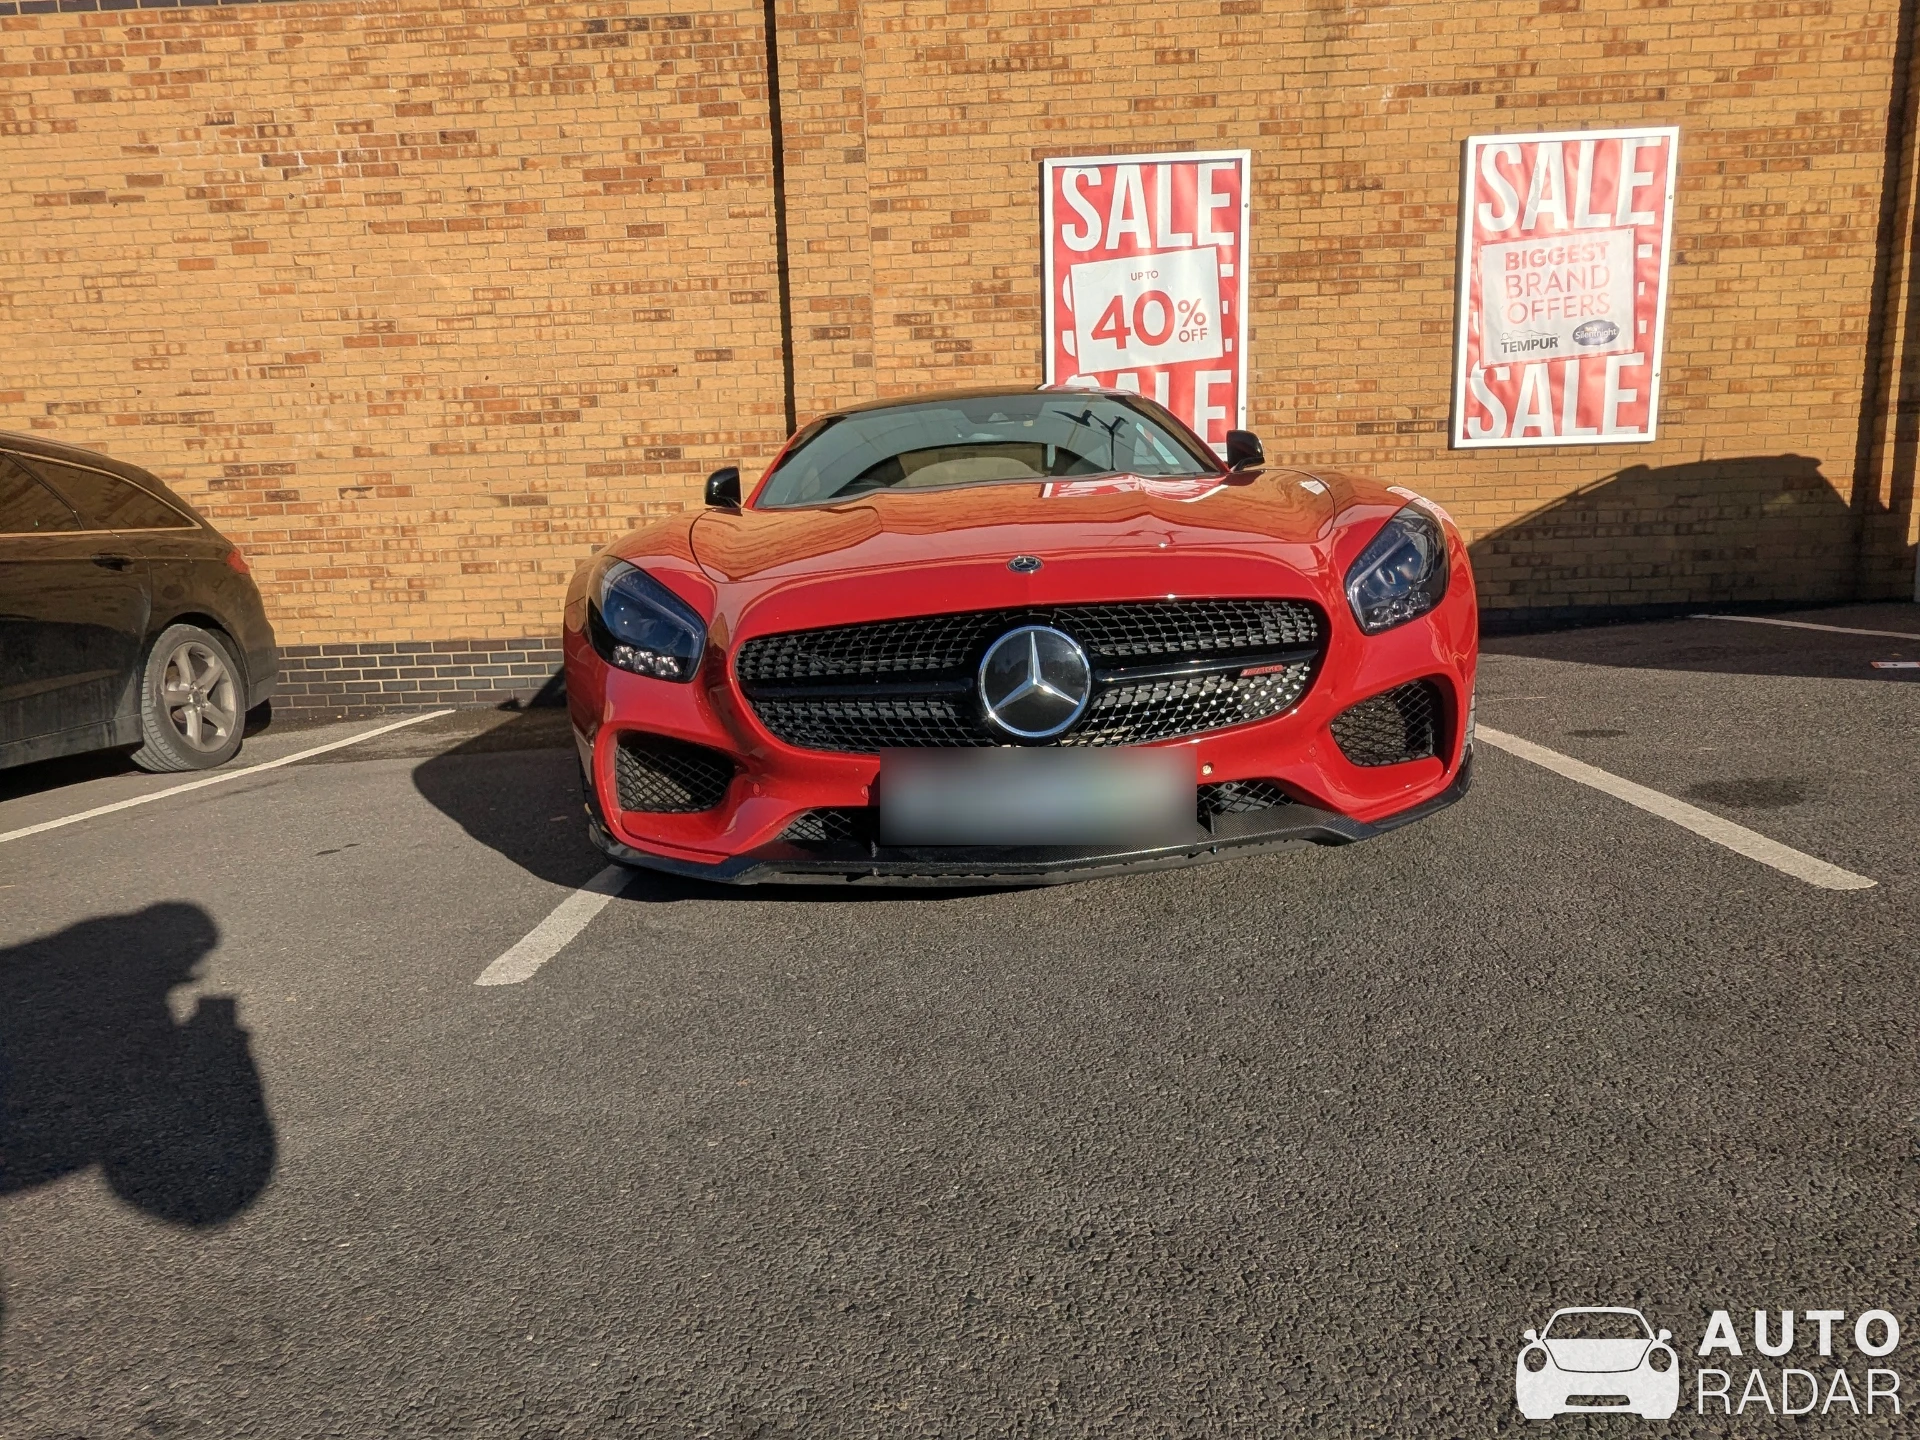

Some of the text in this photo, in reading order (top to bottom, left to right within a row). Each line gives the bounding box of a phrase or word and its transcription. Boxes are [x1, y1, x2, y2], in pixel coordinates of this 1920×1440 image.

[1478, 136, 1662, 232] SALE
[1061, 161, 1236, 252] SALE
[1505, 241, 1610, 271] BIGGEST
[1130, 270, 1159, 281] UP TO
[1505, 264, 1610, 299] BRAND
[1507, 292, 1611, 324] OFFERS
[1178, 328, 1208, 343] OFF
[1501, 337, 1559, 353] TEMPUR
[1575, 327, 1617, 341] Silentnight
[1468, 352, 1645, 439] SALE
